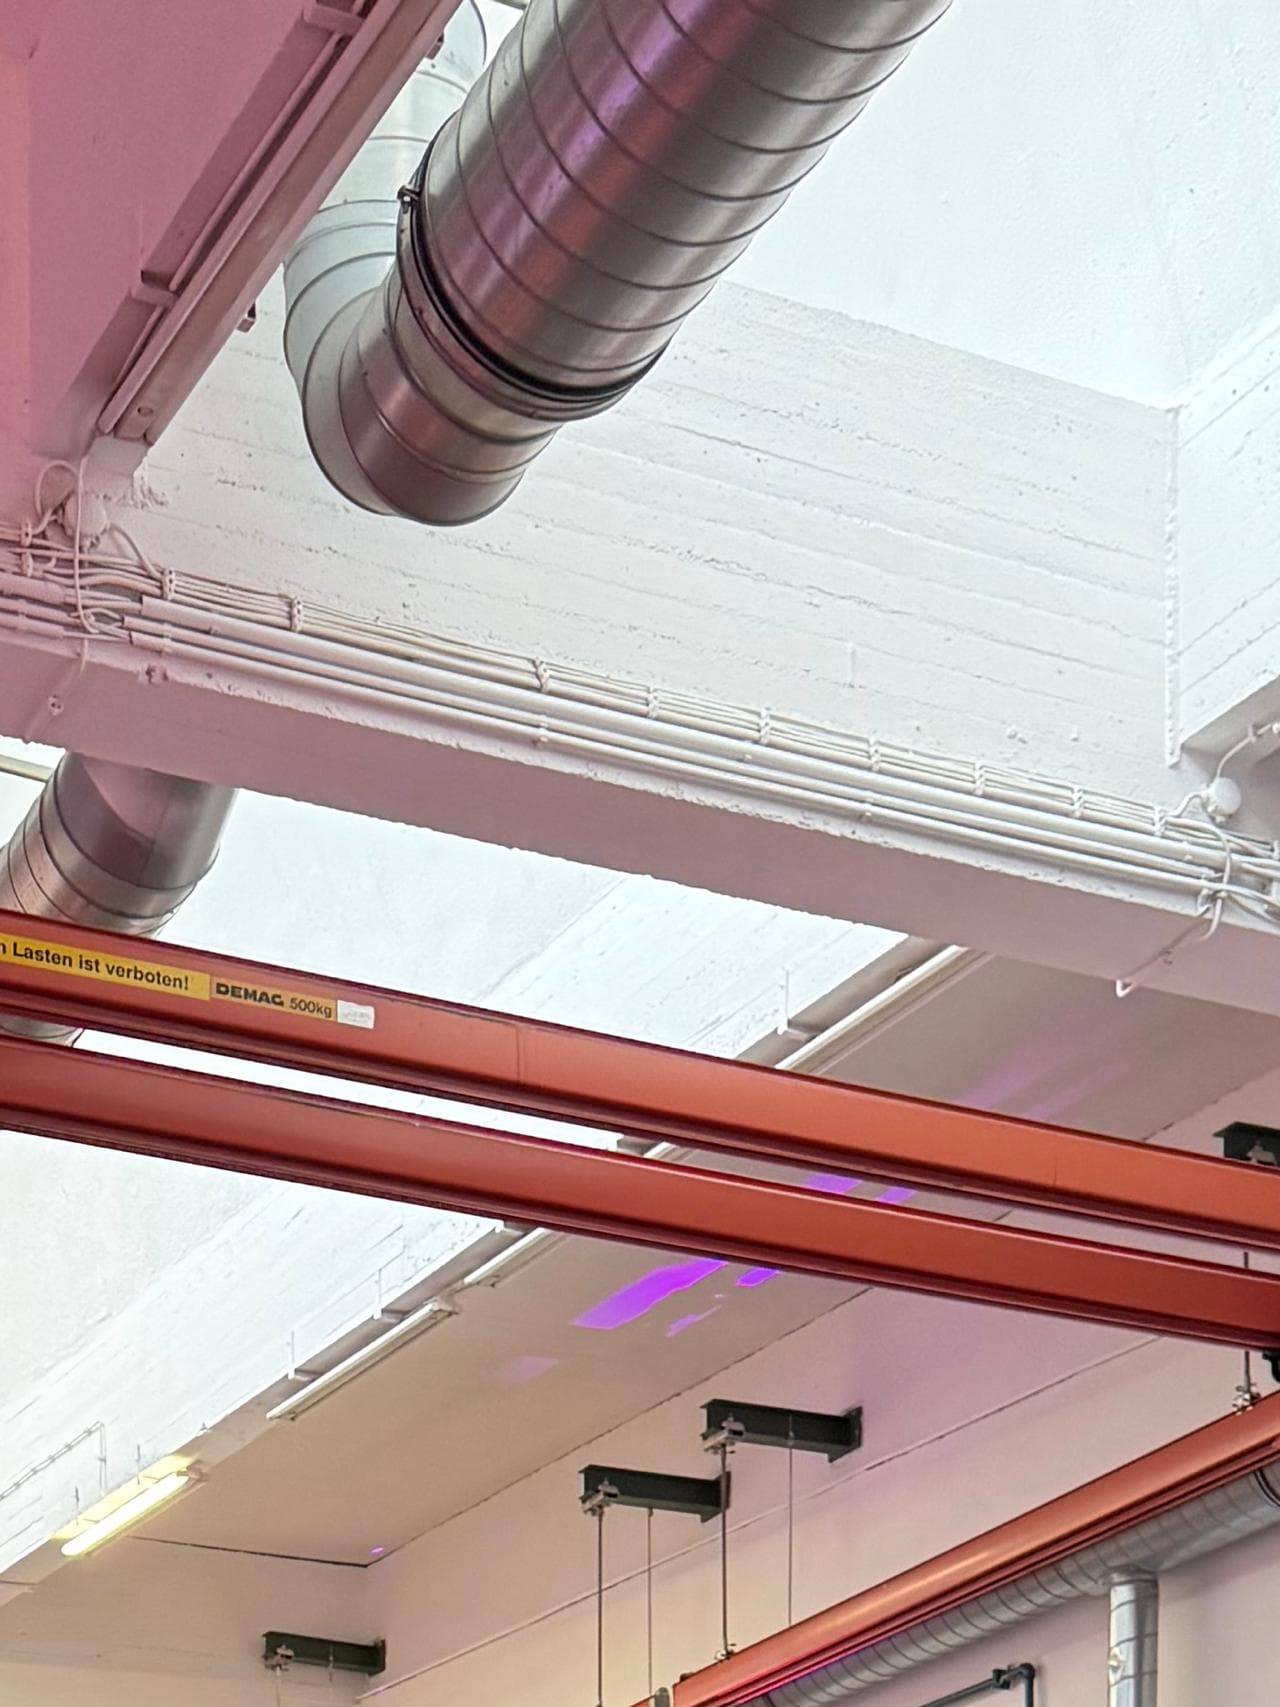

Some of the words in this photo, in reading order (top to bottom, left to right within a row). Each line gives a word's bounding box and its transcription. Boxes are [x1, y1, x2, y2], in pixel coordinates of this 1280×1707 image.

[12, 941, 72, 967] Lasten
[78, 954, 100, 973] ist
[105, 963, 190, 990] verboten!
[215, 982, 285, 1007] DEMAG
[289, 997, 333, 1018] 500kg
